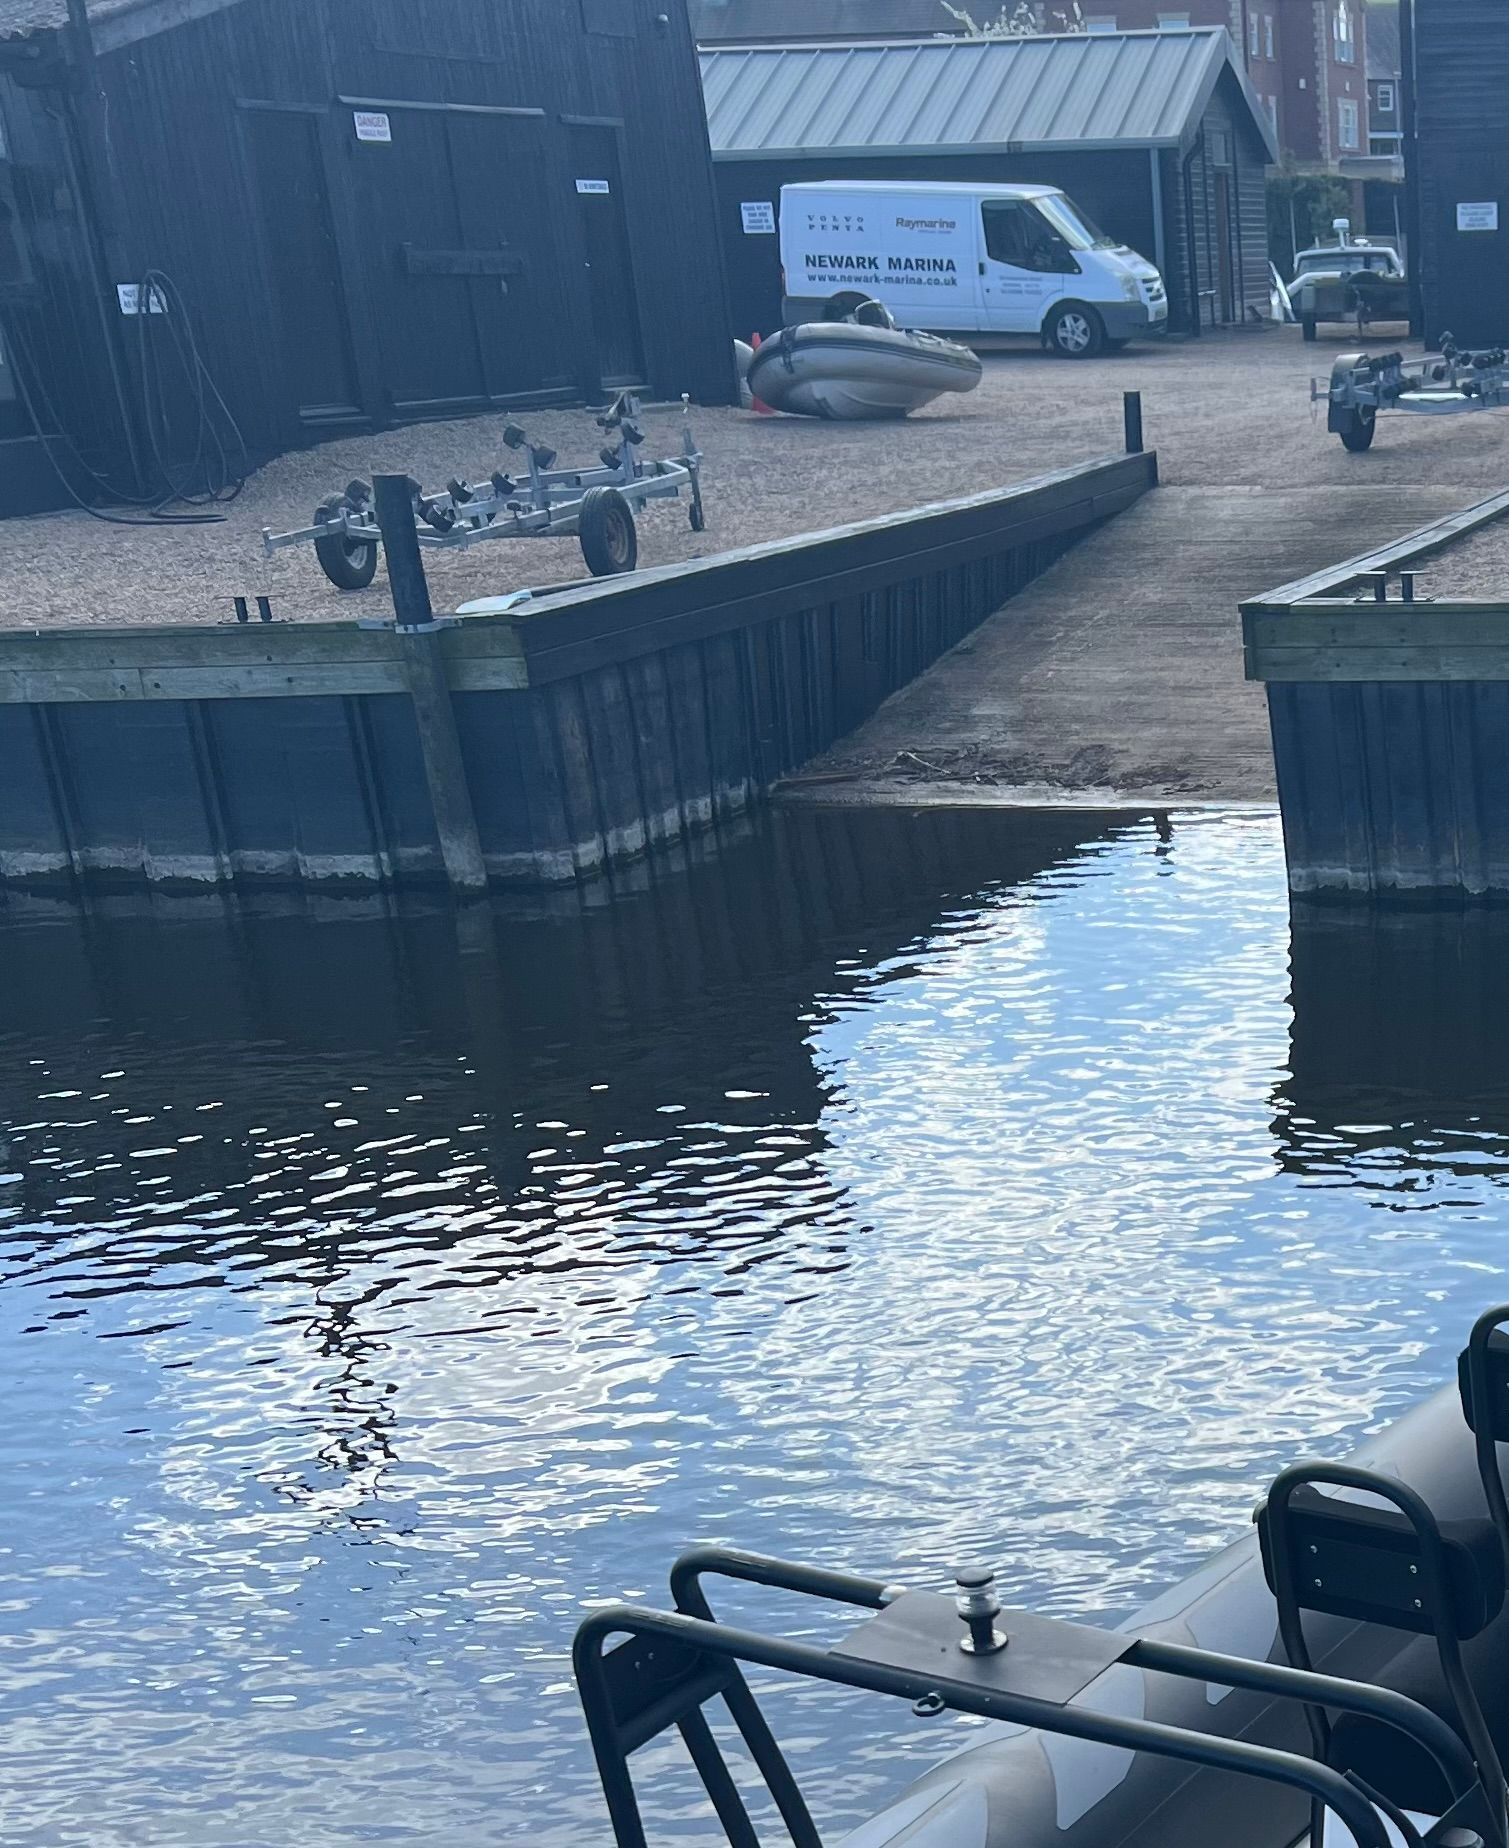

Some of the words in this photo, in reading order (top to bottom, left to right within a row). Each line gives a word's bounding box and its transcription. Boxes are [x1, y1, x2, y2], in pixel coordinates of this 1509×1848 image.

[807, 214, 864, 223] VOLVO
[895, 217, 956, 230] Raymarine
[808, 224, 865, 232] PENTA
[805, 254, 879, 270] NEWARK
[888, 257, 957, 272] MARINA
[807, 273, 958, 287] www.newark-marina.co.uk
